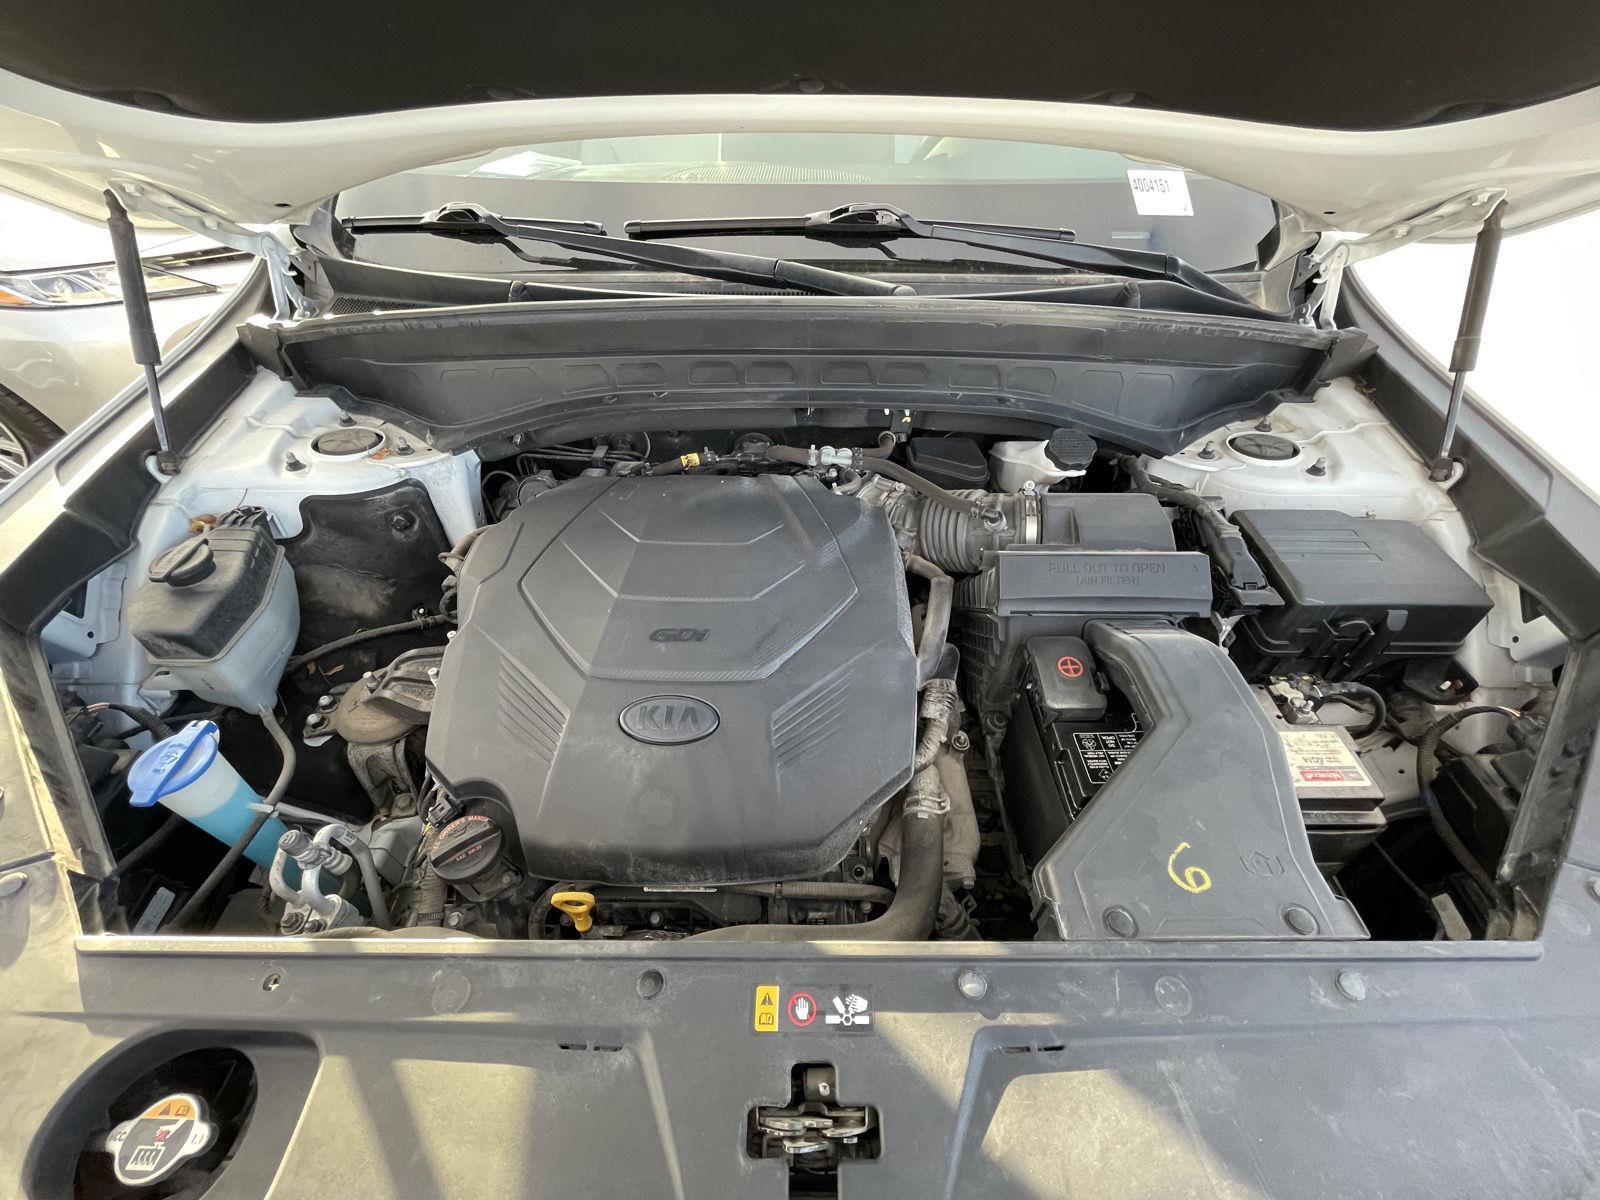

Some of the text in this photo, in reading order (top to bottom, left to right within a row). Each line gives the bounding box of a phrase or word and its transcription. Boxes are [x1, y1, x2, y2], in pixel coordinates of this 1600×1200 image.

[1133, 177, 1170, 193] 4004151
[1048, 562, 1166, 574] PULL OUT TO OPEN
[637, 705, 700, 730] KIA
[1167, 841, 1212, 894] 6
